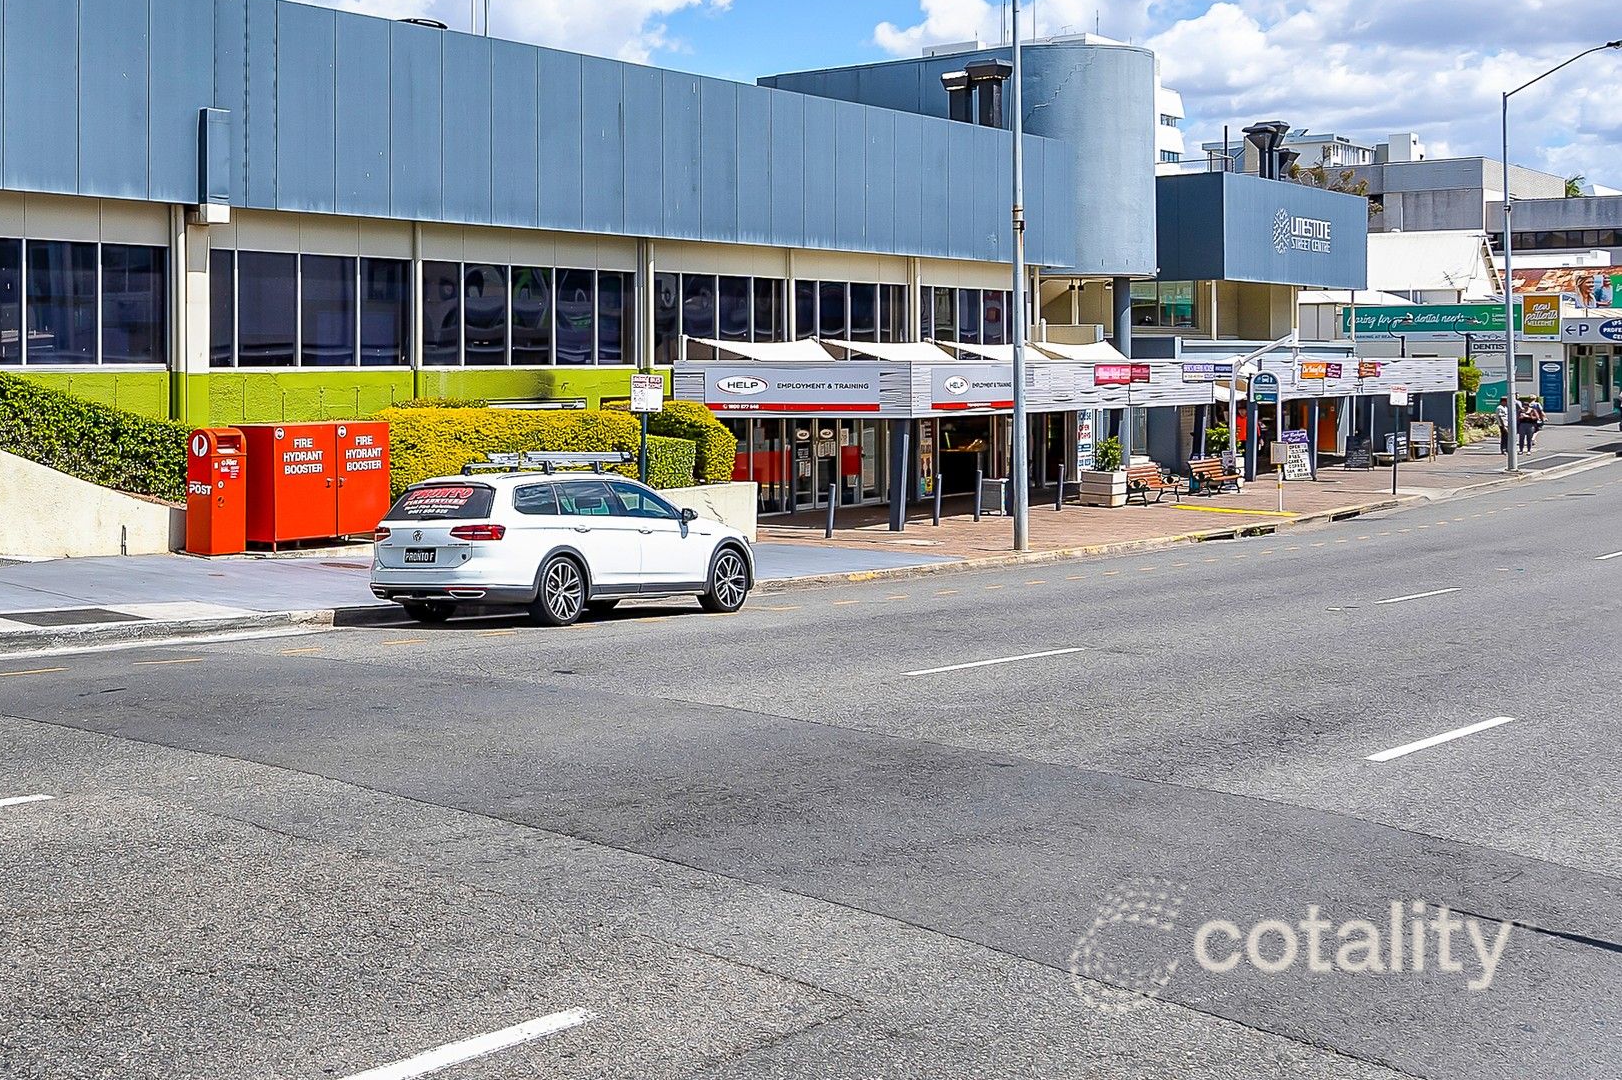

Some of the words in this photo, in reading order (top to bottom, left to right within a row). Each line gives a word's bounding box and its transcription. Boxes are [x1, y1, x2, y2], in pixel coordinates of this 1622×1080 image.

[1290, 216, 1332, 240] LIMESTONE
[1291, 236, 1311, 251] STREET
[1311, 238, 1331, 254] CENTRE
[1579, 324, 1590, 336] P
[293, 438, 313, 448] FIRE
[355, 435, 374, 446] FIRE
[283, 450, 324, 462] HYDRANT
[345, 447, 382, 459] HYDRANT
[284, 464, 323, 474] BOOSTER
[346, 460, 382, 471] BOOSTER
[189, 484, 212, 495] POST
[408, 487, 474, 500] PRONTO
[405, 552, 428, 561] PRONTO
[429, 552, 434, 561] F
